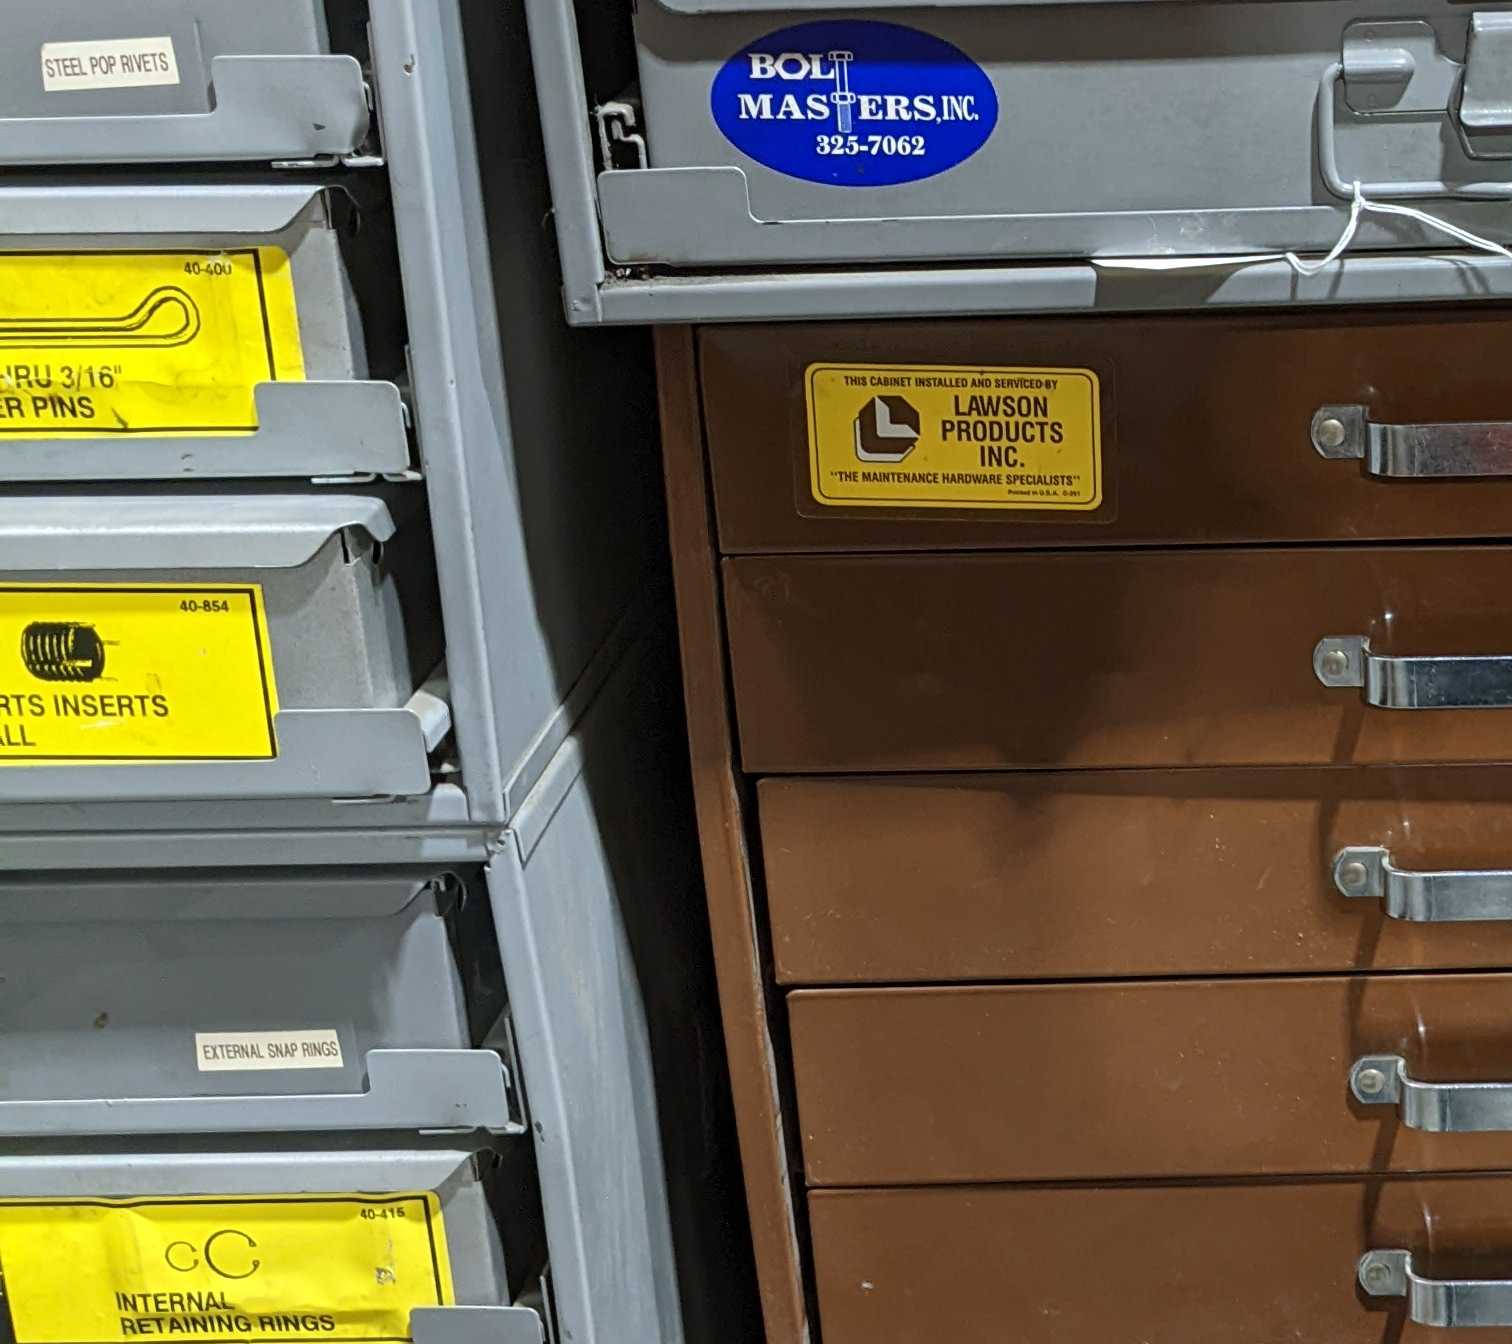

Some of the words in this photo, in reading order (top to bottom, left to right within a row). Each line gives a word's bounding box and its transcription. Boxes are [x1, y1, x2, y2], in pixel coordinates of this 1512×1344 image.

[44, 58, 87, 78] STEEL
[90, 56, 117, 75] POP
[120, 52, 169, 73] RIVETS
[816, 135, 925, 156] 325-7062
[60, 364, 122, 390] 3/16"
[844, 376, 867, 387] THIS
[870, 376, 912, 388] CABINET
[915, 377, 968, 389] INSTALLED
[971, 378, 992, 389] AND
[994, 378, 1041, 390] SERVICED
[1045, 380, 1058, 390] BY
[32, 396, 95, 419] PINS
[954, 395, 1048, 418] LAWSON
[940, 420, 1063, 444] PRODUCTS
[980, 446, 1025, 468] INC.
[862, 472, 939, 484] MAINTENANCE
[942, 473, 1003, 485] HARDWARE
[179, 600, 229, 613] 40-854
[54, 695, 169, 717] INSERTS
[203, 1043, 265, 1060] EXTERNAL
[268, 1042, 298, 1058] SNAP
[301, 1040, 338, 1057] RINGS
[361, 1207, 406, 1219] 40-415
[115, 1291, 235, 1313] INTERNAL
[120, 1315, 252, 1335] RETAINING
[259, 1314, 335, 1333] RINGS
